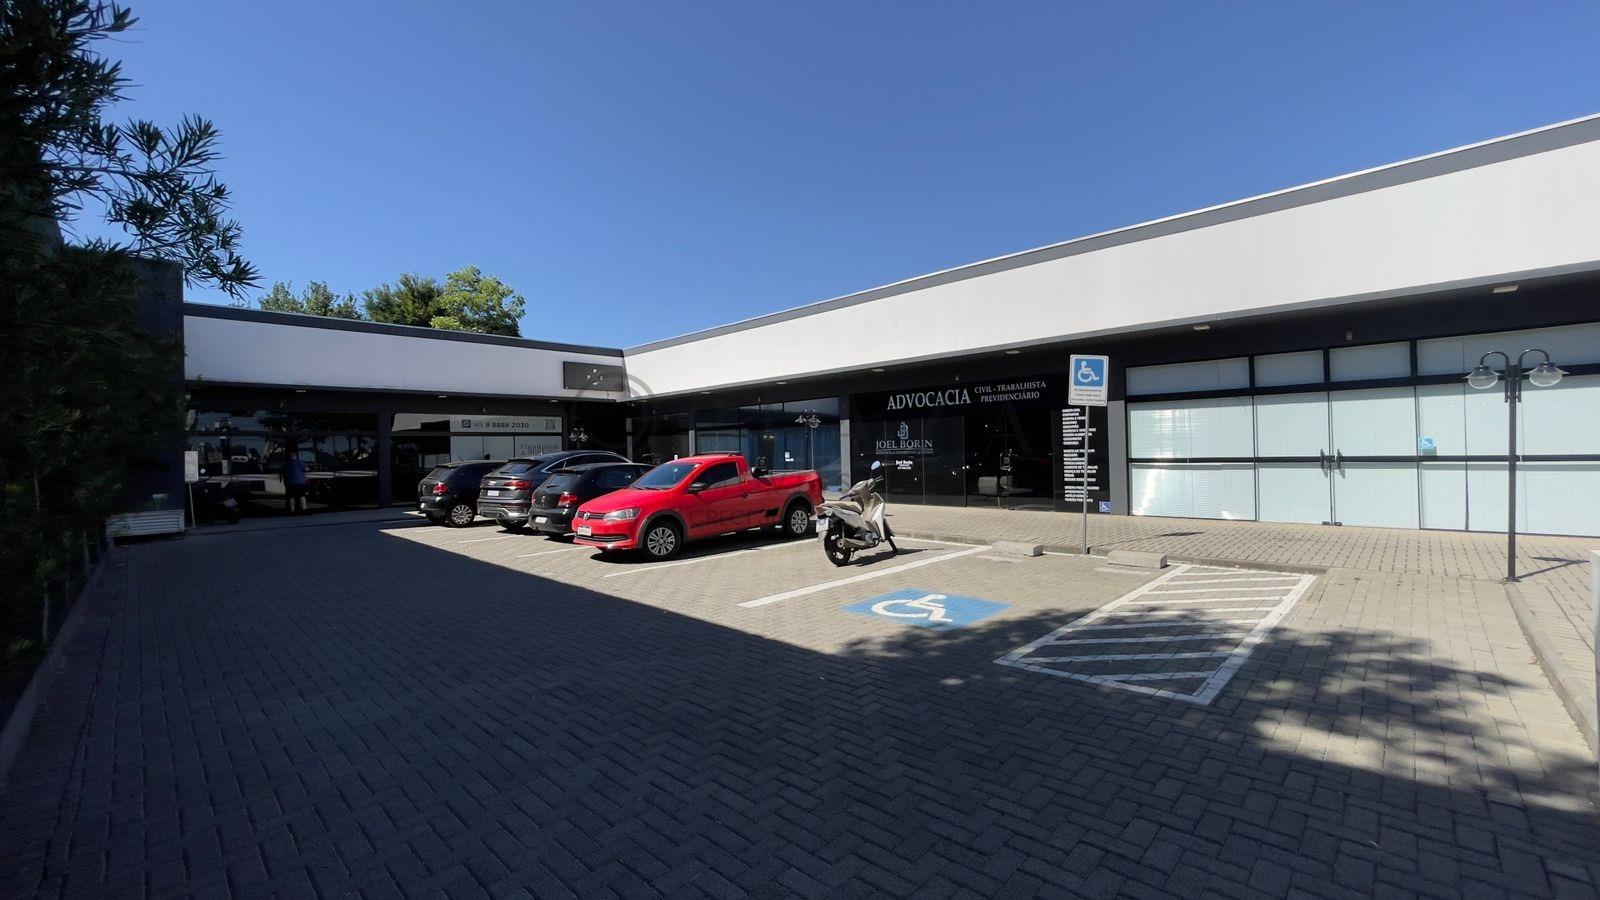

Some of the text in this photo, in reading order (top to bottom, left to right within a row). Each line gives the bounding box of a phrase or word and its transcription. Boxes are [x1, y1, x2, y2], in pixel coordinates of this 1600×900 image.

[974, 381, 1047, 394] CIVIL TRABALHISTA
[887, 388, 972, 410] ADVOCACIA
[980, 390, 1040, 403] PREVIDENCIÁRIO
[511, 422, 530, 430] 2030
[875, 439, 934, 451] JOEL BORIN
